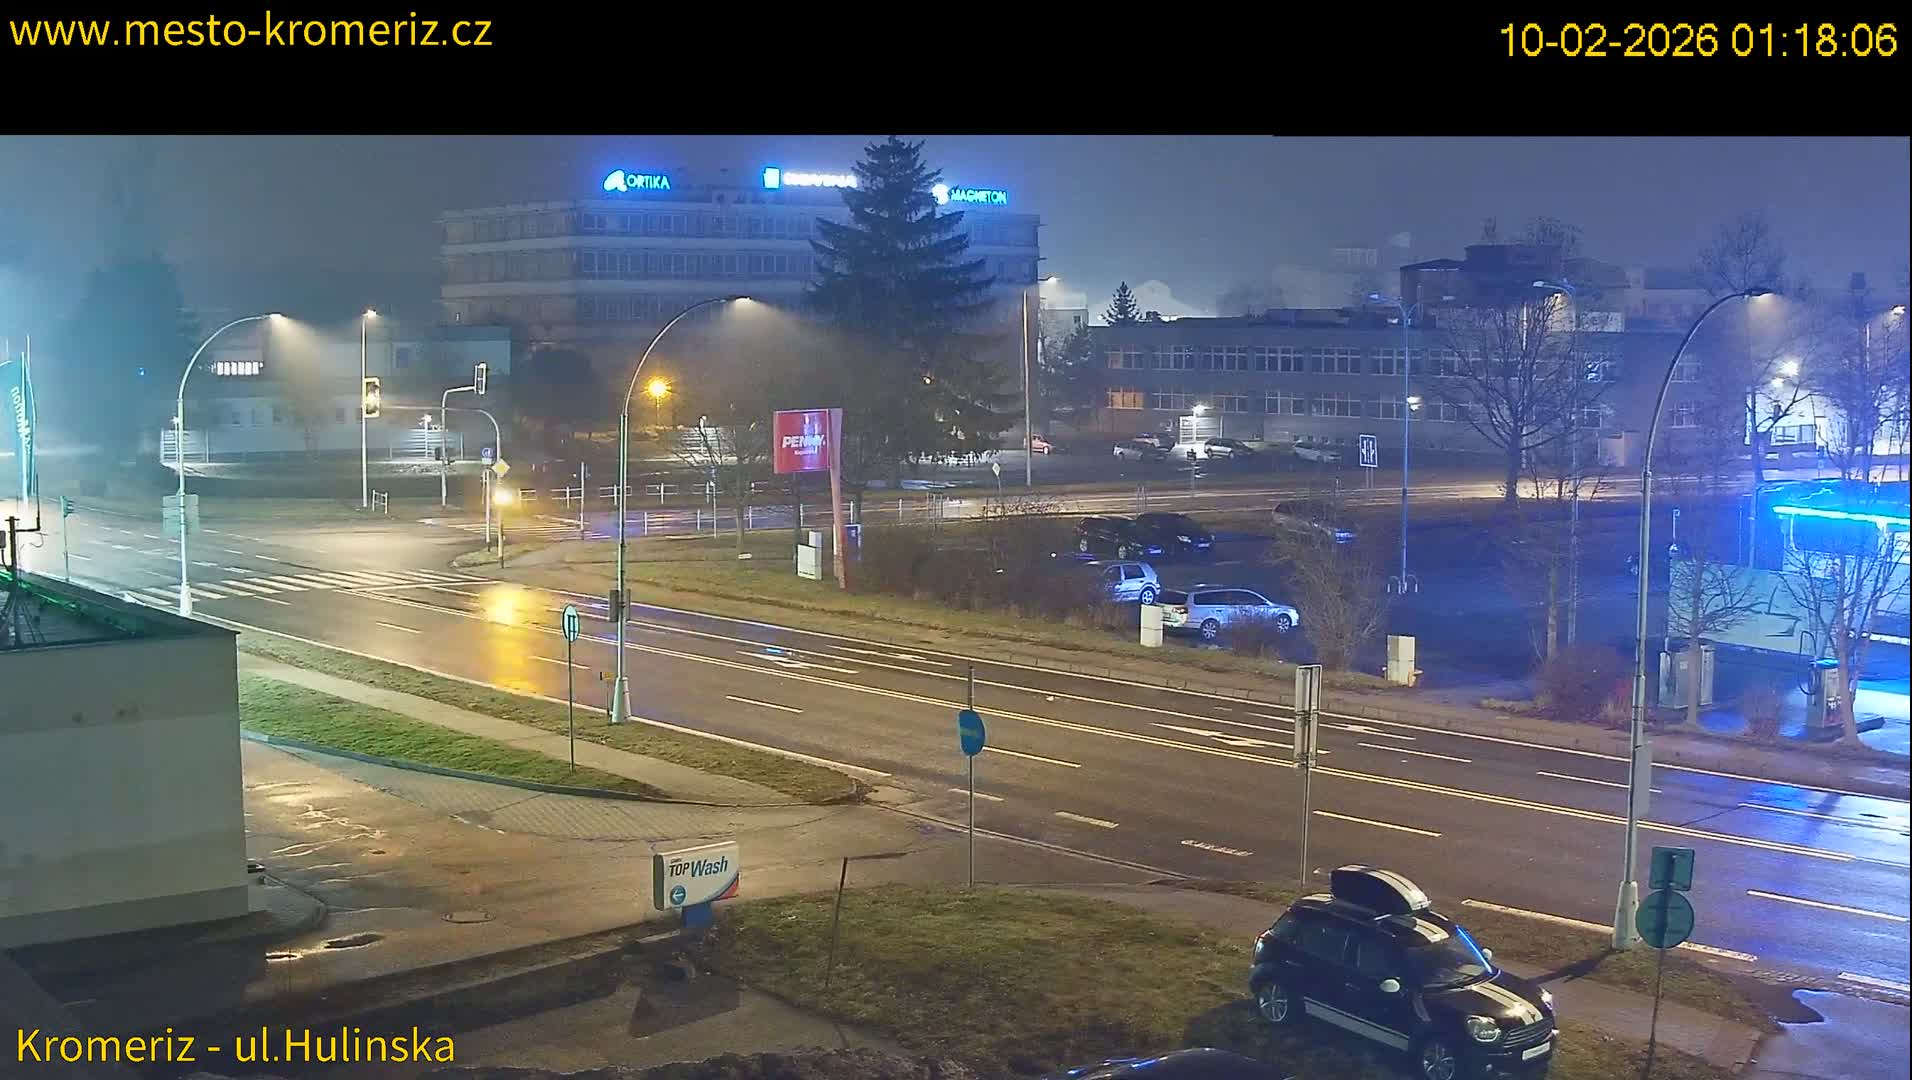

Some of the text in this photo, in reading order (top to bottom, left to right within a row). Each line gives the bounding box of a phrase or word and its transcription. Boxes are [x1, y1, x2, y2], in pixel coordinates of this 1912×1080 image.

[626, 173, 671, 190] ORTIKA
[950, 187, 1008, 204] MAGNETON
[669, 862, 690, 878] TOP
[691, 856, 728, 877] Wash
